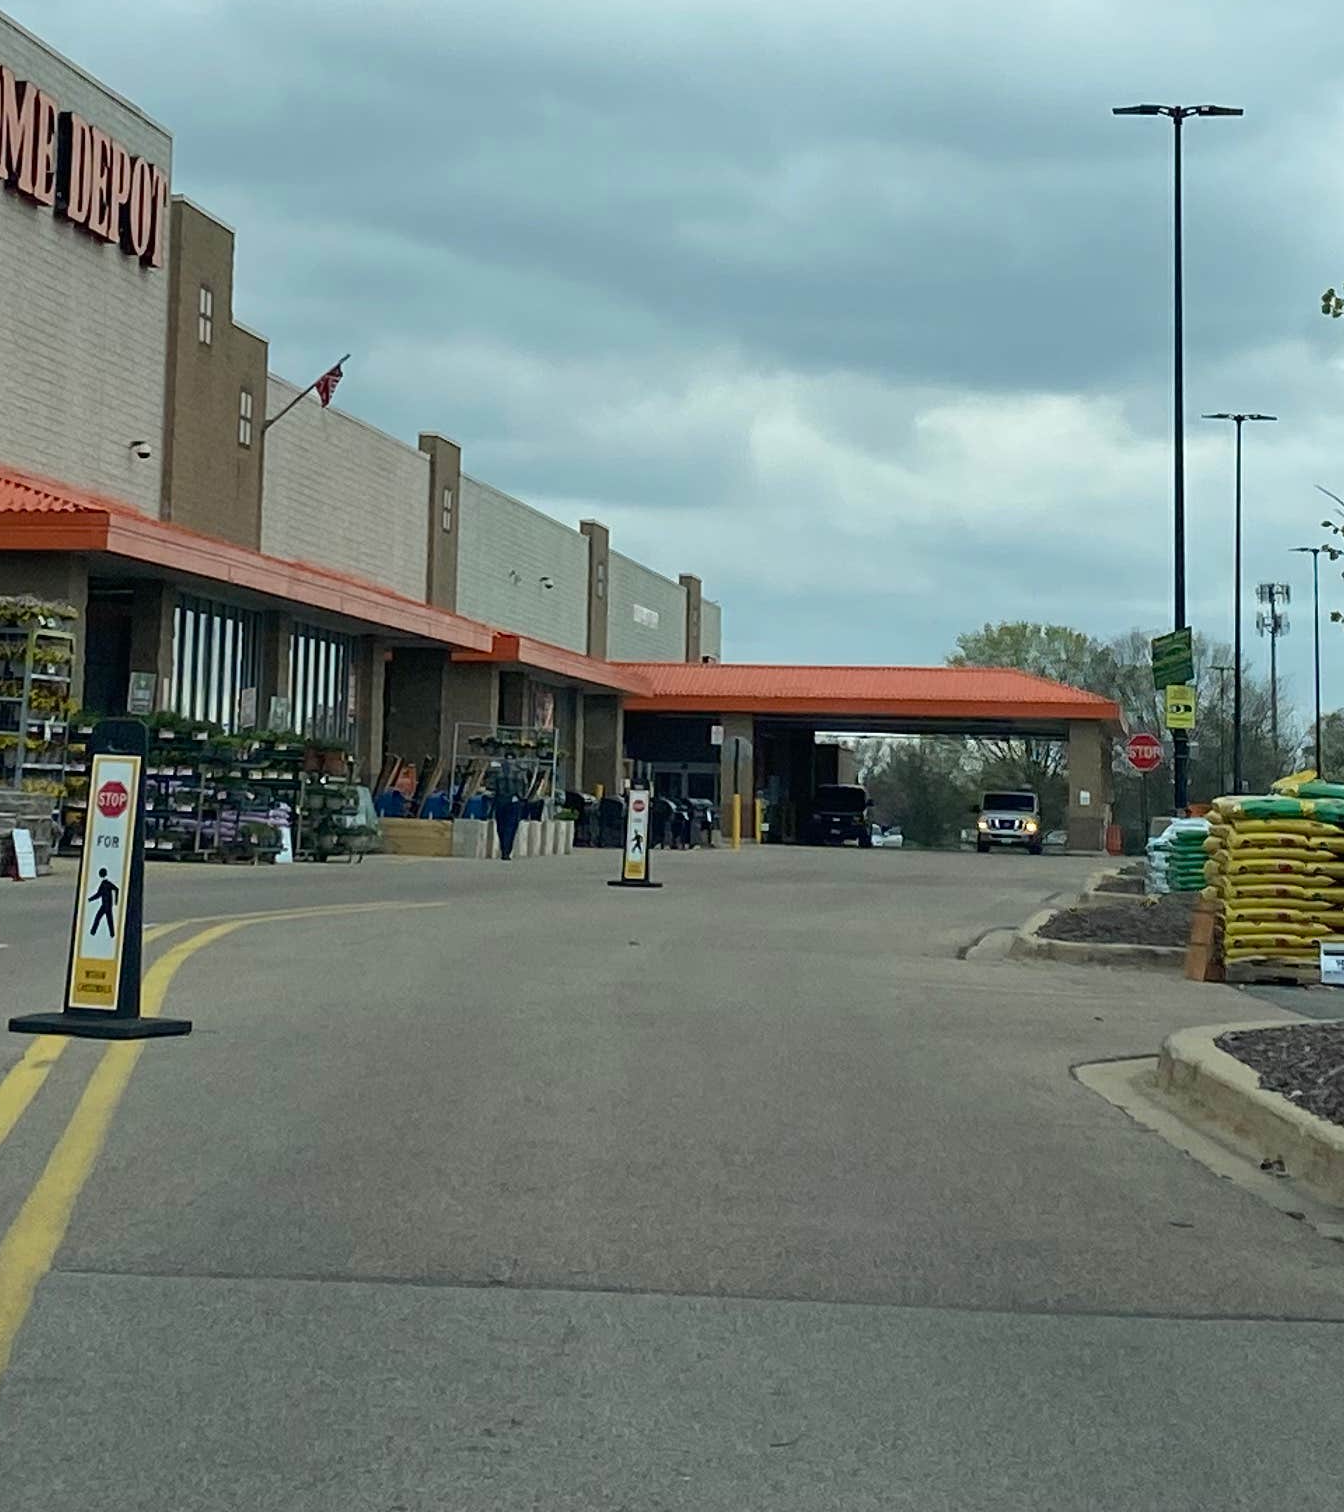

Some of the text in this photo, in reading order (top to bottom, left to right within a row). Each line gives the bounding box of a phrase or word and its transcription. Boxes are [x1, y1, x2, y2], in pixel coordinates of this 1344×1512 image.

[58, 111, 168, 269] DEPOT
[1128, 744, 1161, 759] STOP
[98, 791, 128, 807] STOP
[96, 834, 120, 849] FOR
